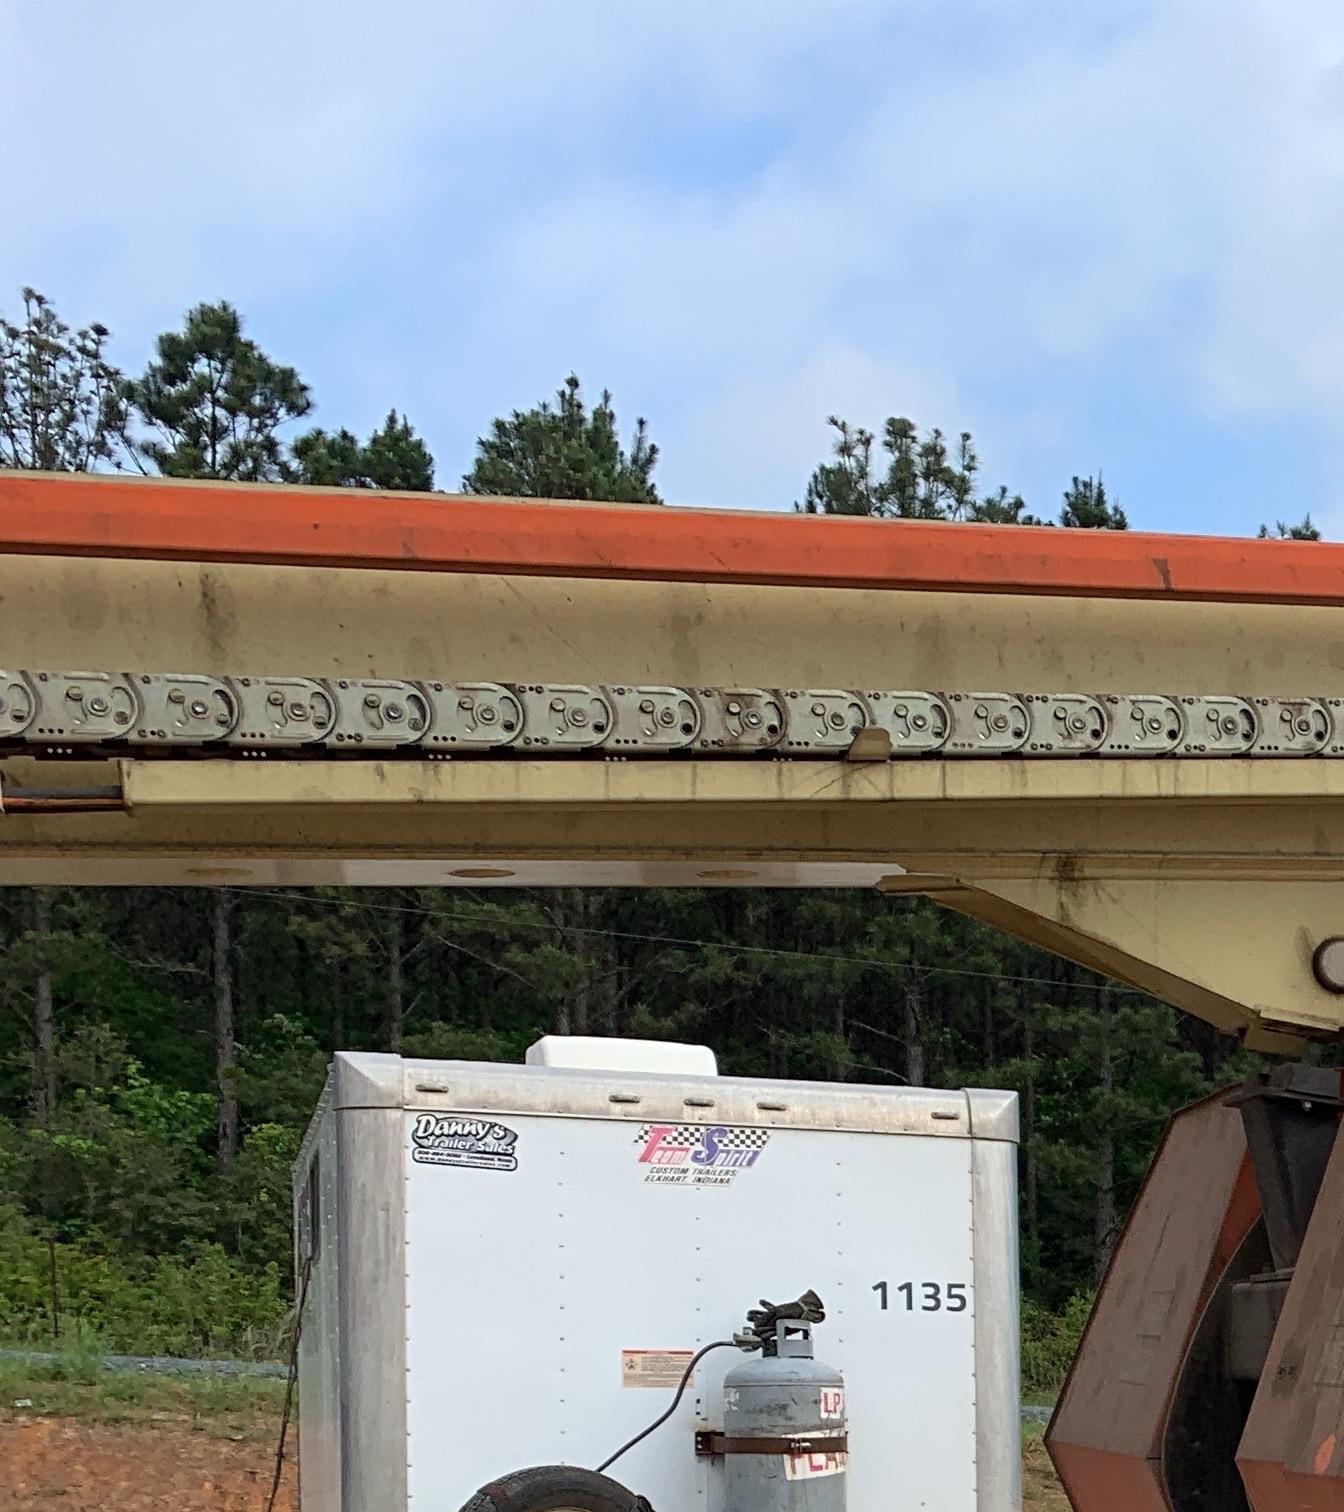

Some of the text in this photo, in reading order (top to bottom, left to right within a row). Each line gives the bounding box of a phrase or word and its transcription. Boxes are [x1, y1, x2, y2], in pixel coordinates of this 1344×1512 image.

[415, 1114, 507, 1141] Danny's
[427, 1136, 513, 1154] Trailer Sales
[690, 1127, 761, 1167] Spirit
[649, 1167, 737, 1177] CUSTOM TRAILERS
[692, 1176, 732, 1184] INDIANA
[872, 1281, 967, 1312] 1135
[823, 1393, 840, 1413] LP
